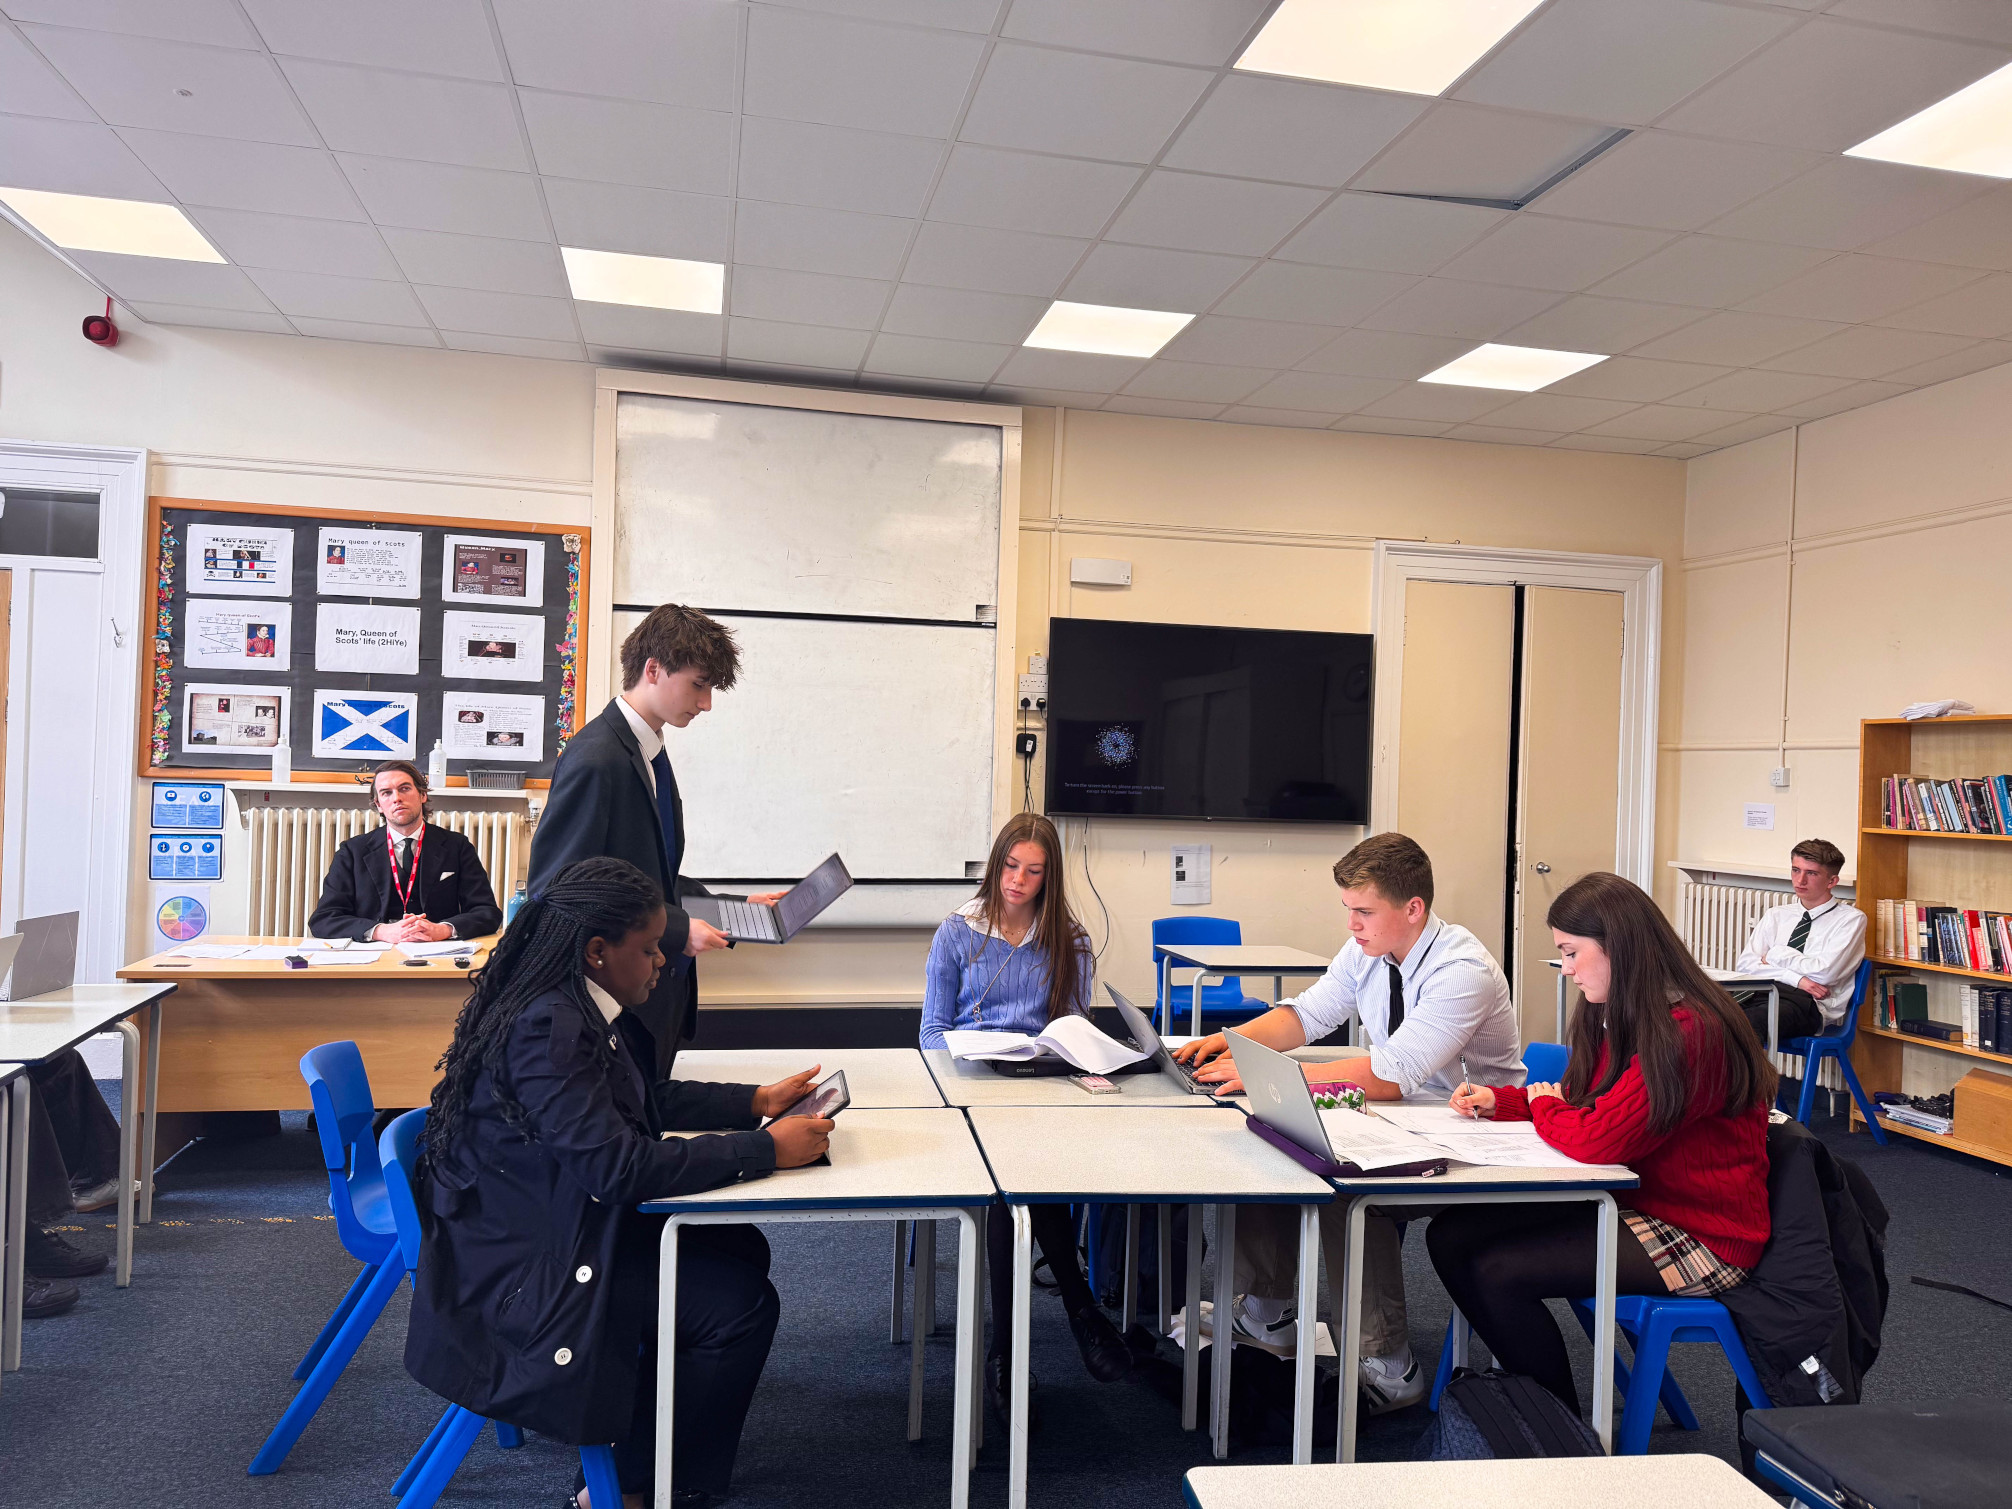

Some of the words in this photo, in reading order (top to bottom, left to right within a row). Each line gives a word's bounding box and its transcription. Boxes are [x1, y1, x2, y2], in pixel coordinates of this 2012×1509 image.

[335, 628, 358, 637] Mary,
[360, 629, 387, 637] Queen
[335, 637, 362, 645] Scots'
